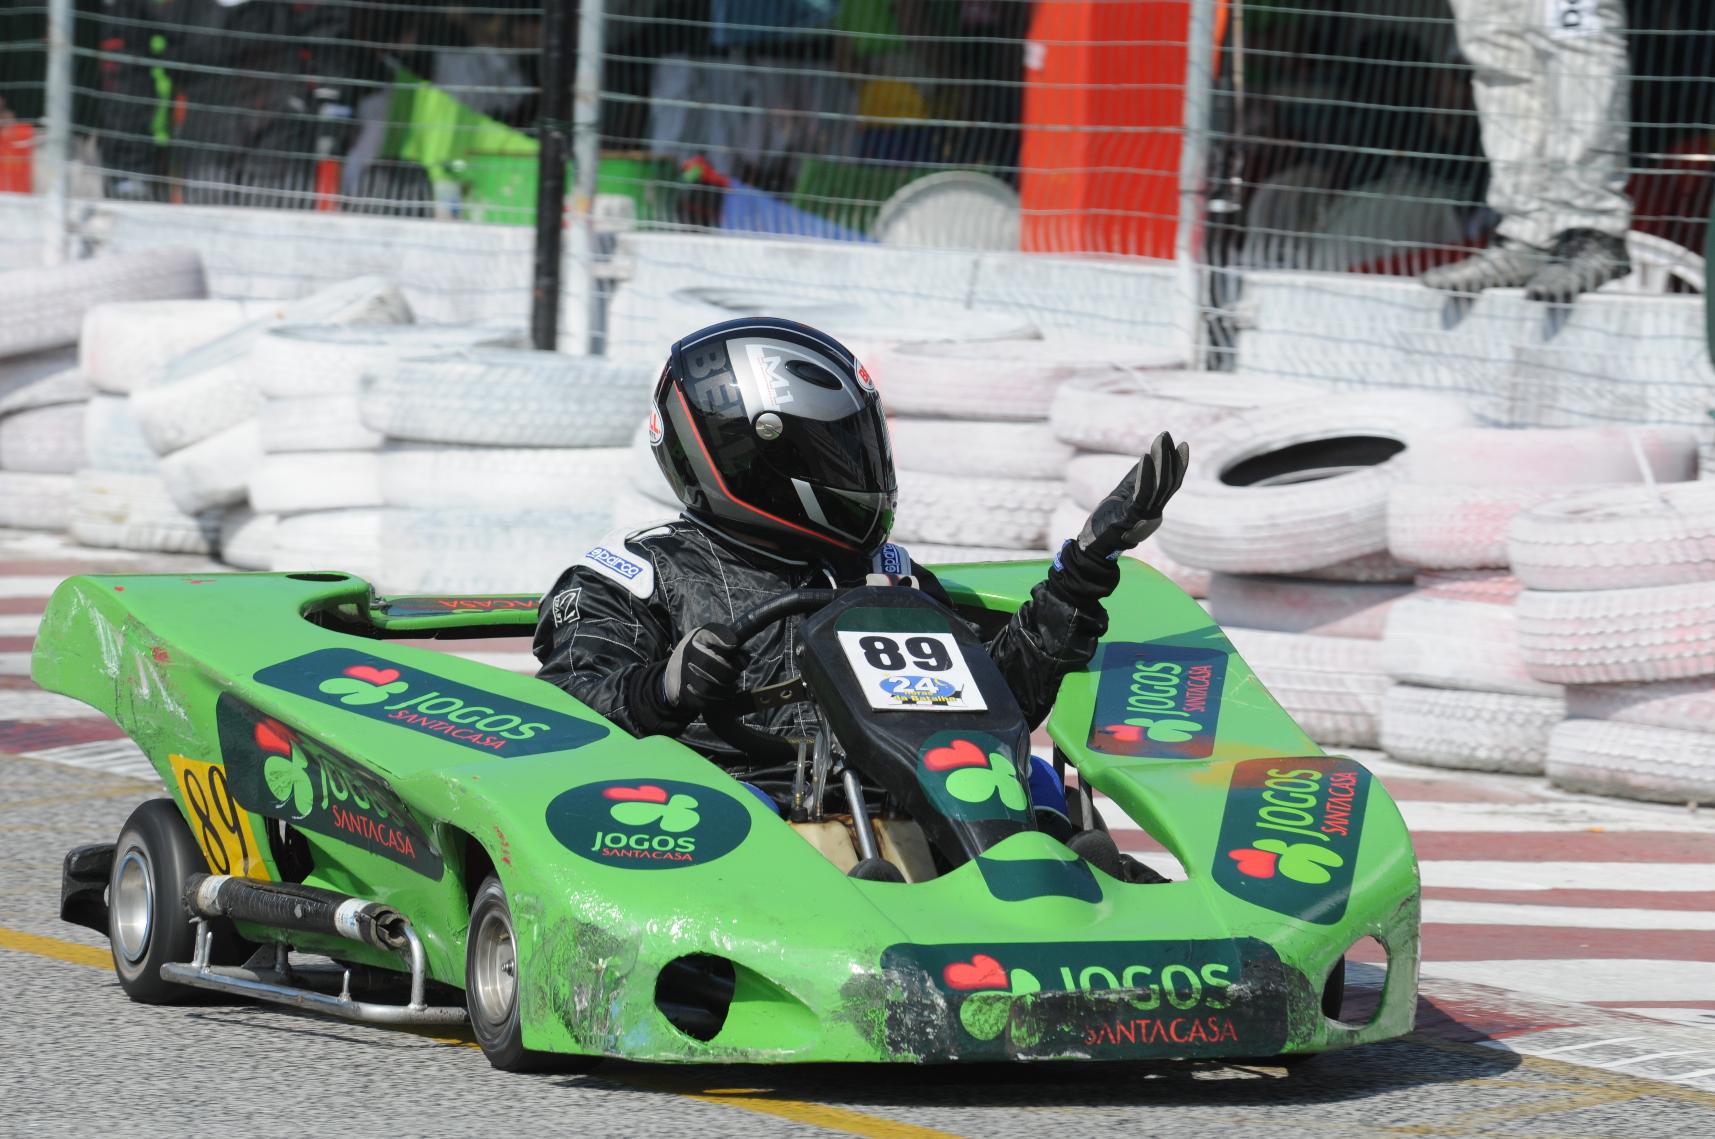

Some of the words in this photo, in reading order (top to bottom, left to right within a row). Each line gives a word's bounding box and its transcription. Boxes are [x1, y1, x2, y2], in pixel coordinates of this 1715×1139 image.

[761, 354, 795, 406] M1
[590, 548, 641, 578] sparco
[859, 636, 953, 671] 89
[889, 676, 939, 694] 24
[1126, 660, 1191, 717] JOGOS
[1183, 664, 1213, 713] SANTACASA
[384, 692, 551, 740] JOGOS
[388, 709, 507, 750] SANTACASA
[183, 765, 250, 877] 89
[1255, 768, 1331, 842] JOGOS
[1320, 771, 1359, 837] SANTACASA
[332, 804, 416, 859] SANTACASA
[591, 831, 696, 853] JOGOS
[602, 847, 693, 862] SANTACASA
